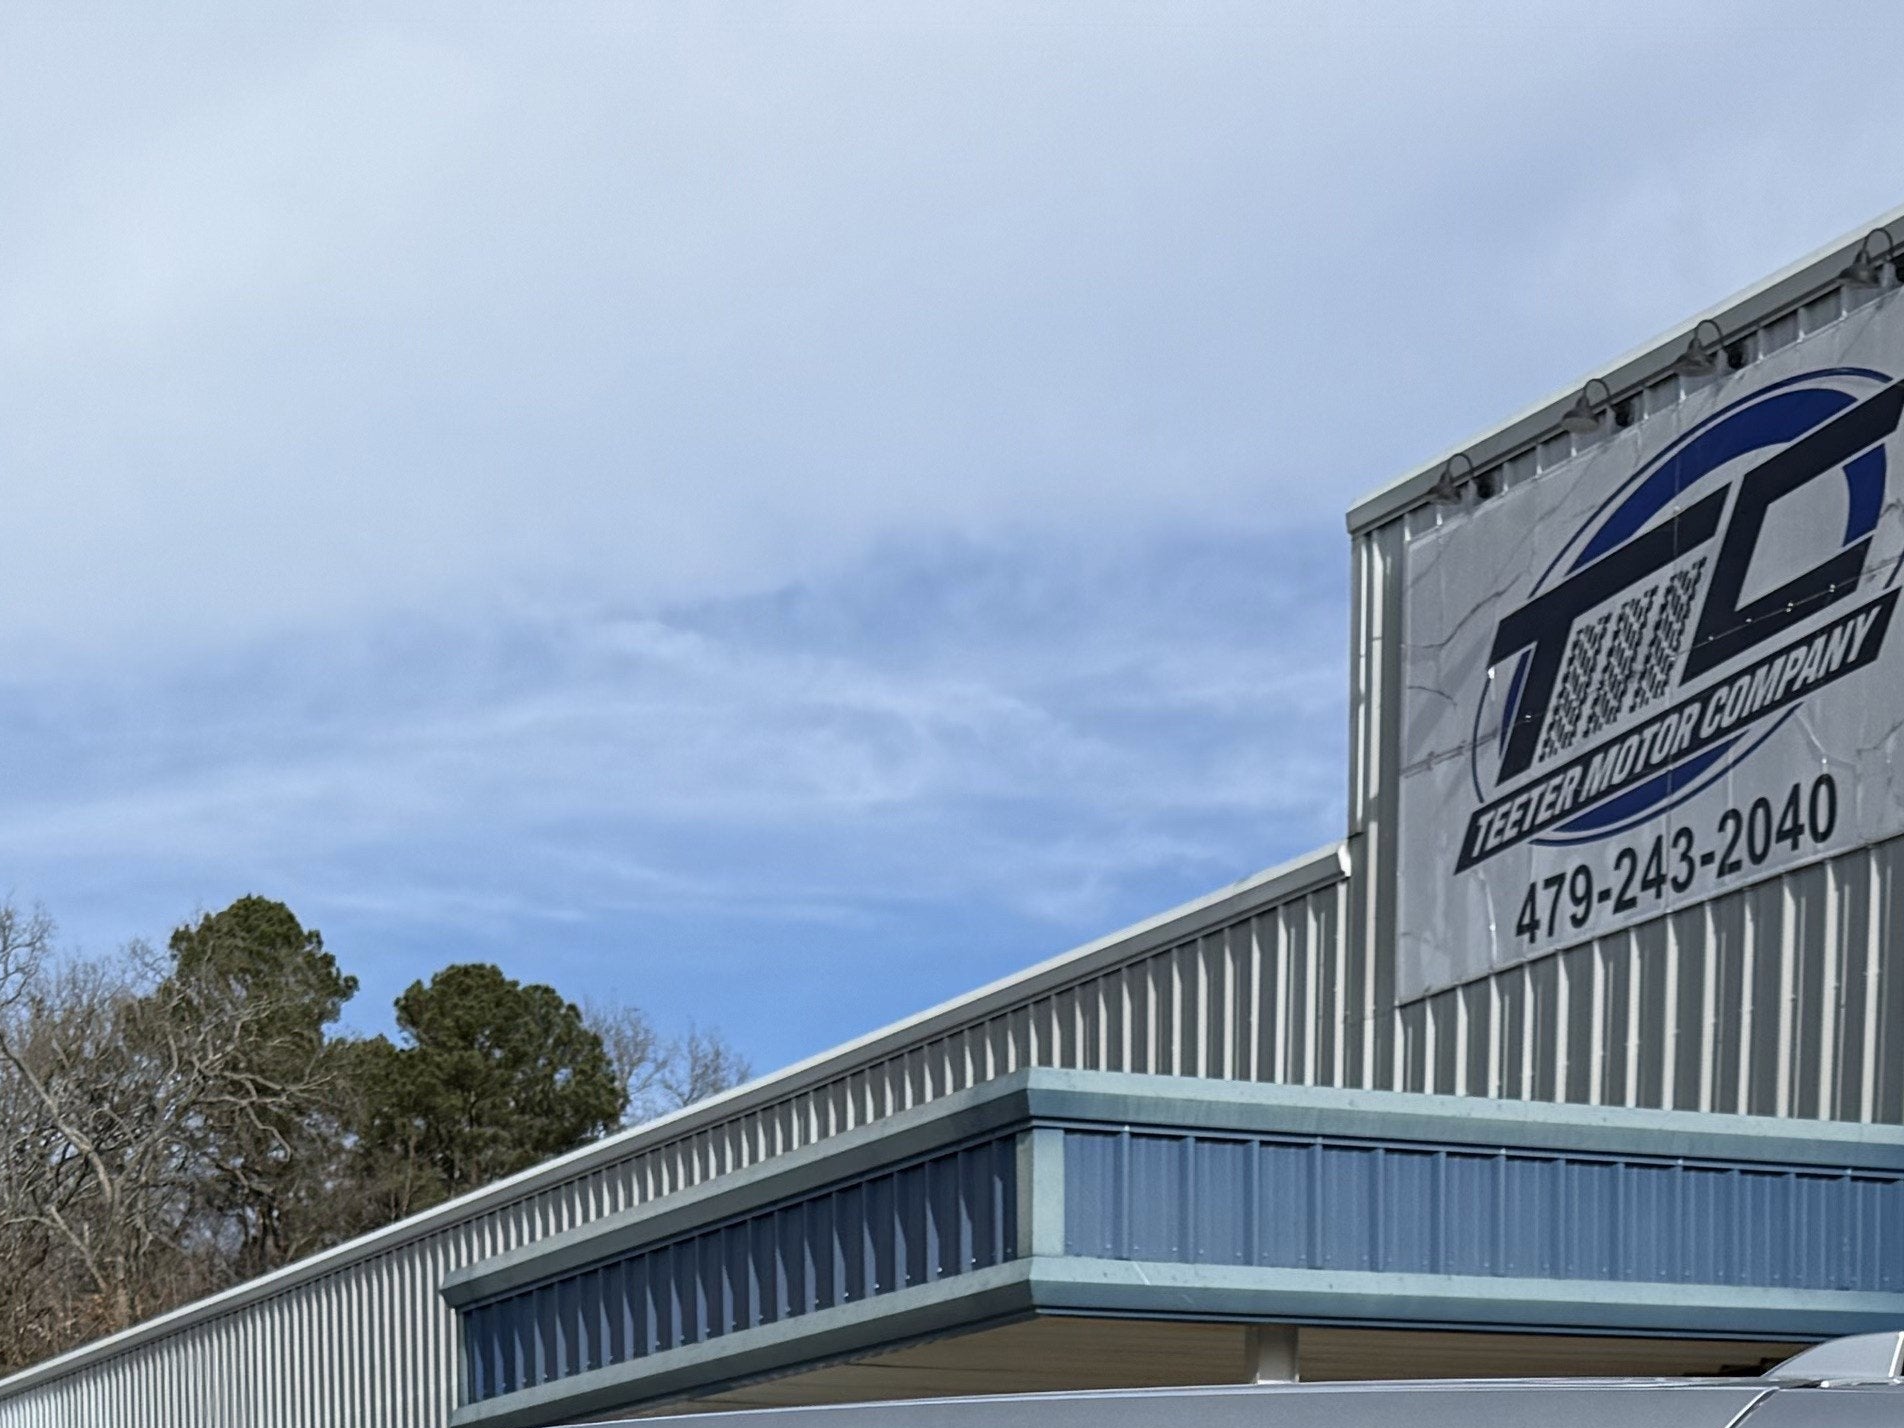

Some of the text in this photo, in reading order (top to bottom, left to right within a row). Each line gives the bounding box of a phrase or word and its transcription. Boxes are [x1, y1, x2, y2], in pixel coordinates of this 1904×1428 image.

[1472, 604, 1883, 858] TEETER MOTOR COMPANY
[1515, 773, 1838, 945] 479-243-2040
